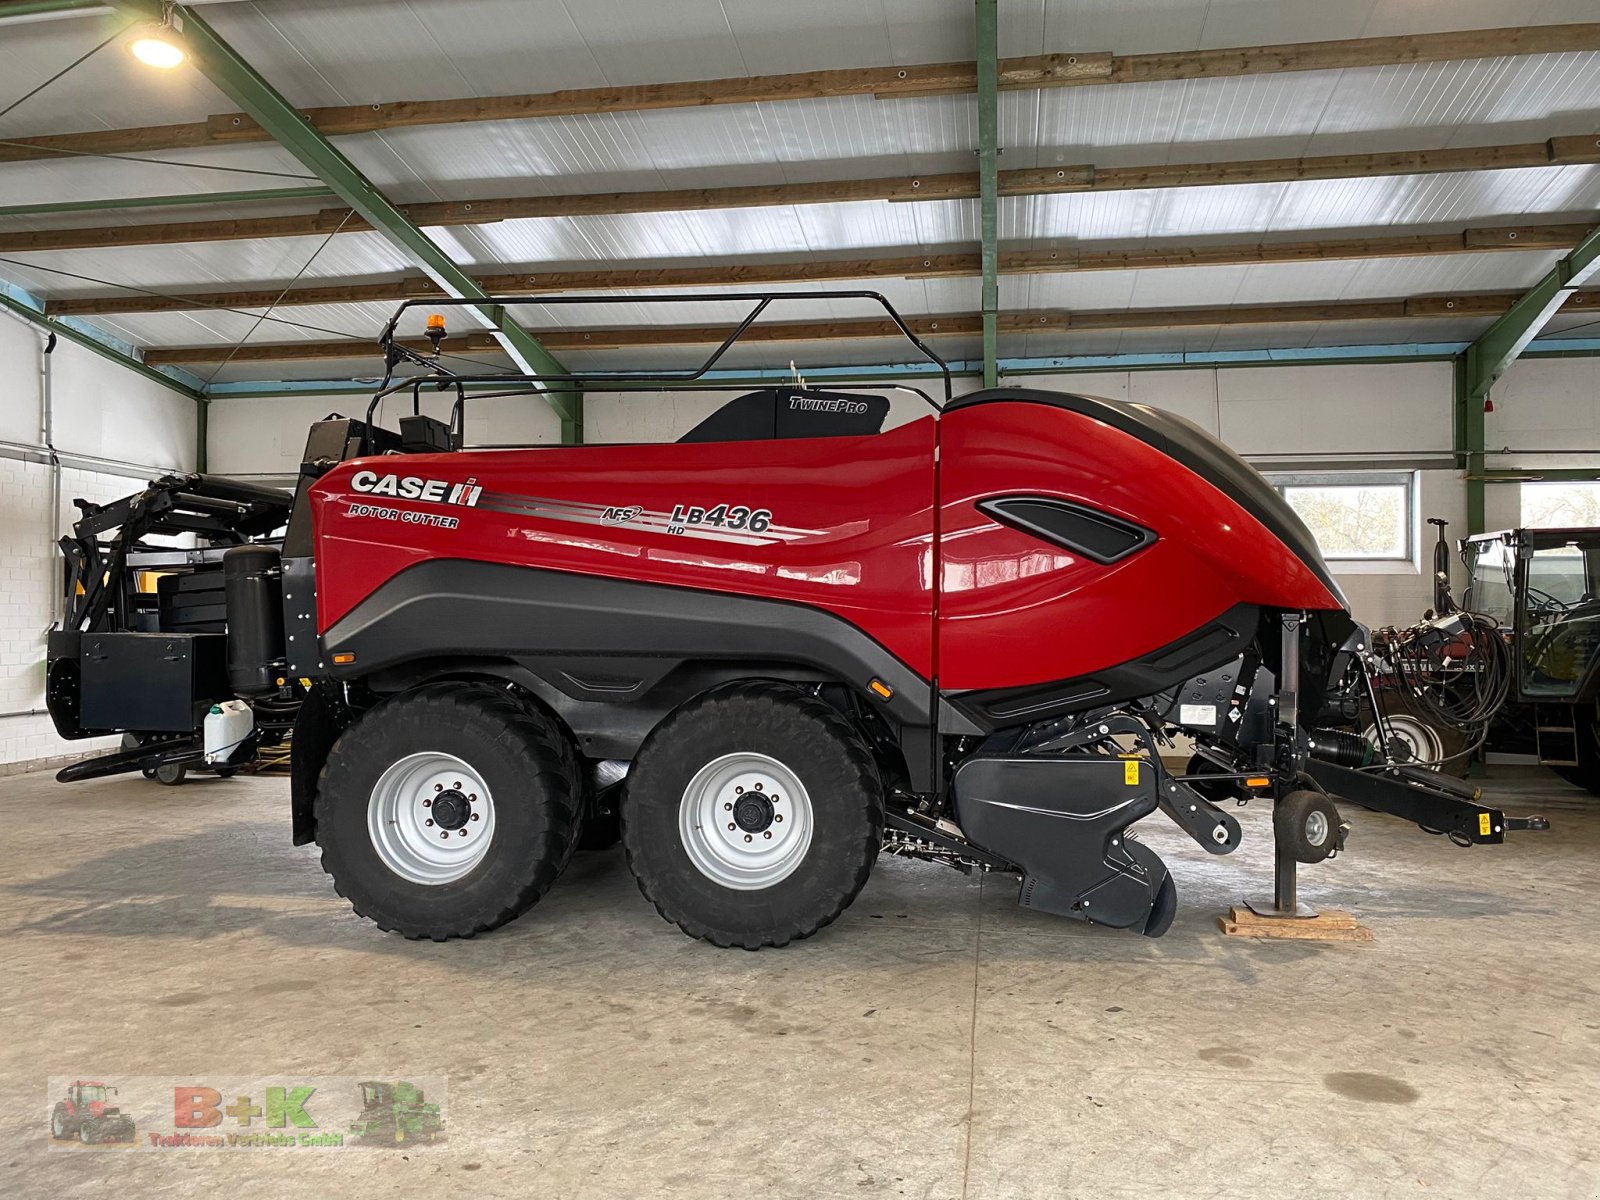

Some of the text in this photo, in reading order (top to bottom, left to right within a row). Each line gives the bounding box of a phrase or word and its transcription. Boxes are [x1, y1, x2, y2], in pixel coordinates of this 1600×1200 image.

[350, 470, 448, 502] CASE
[350, 503, 460, 529] ROTOR CUTTER
[601, 506, 634, 521] AFS
[671, 503, 773, 533] LB436
[667, 525, 685, 535] HD
